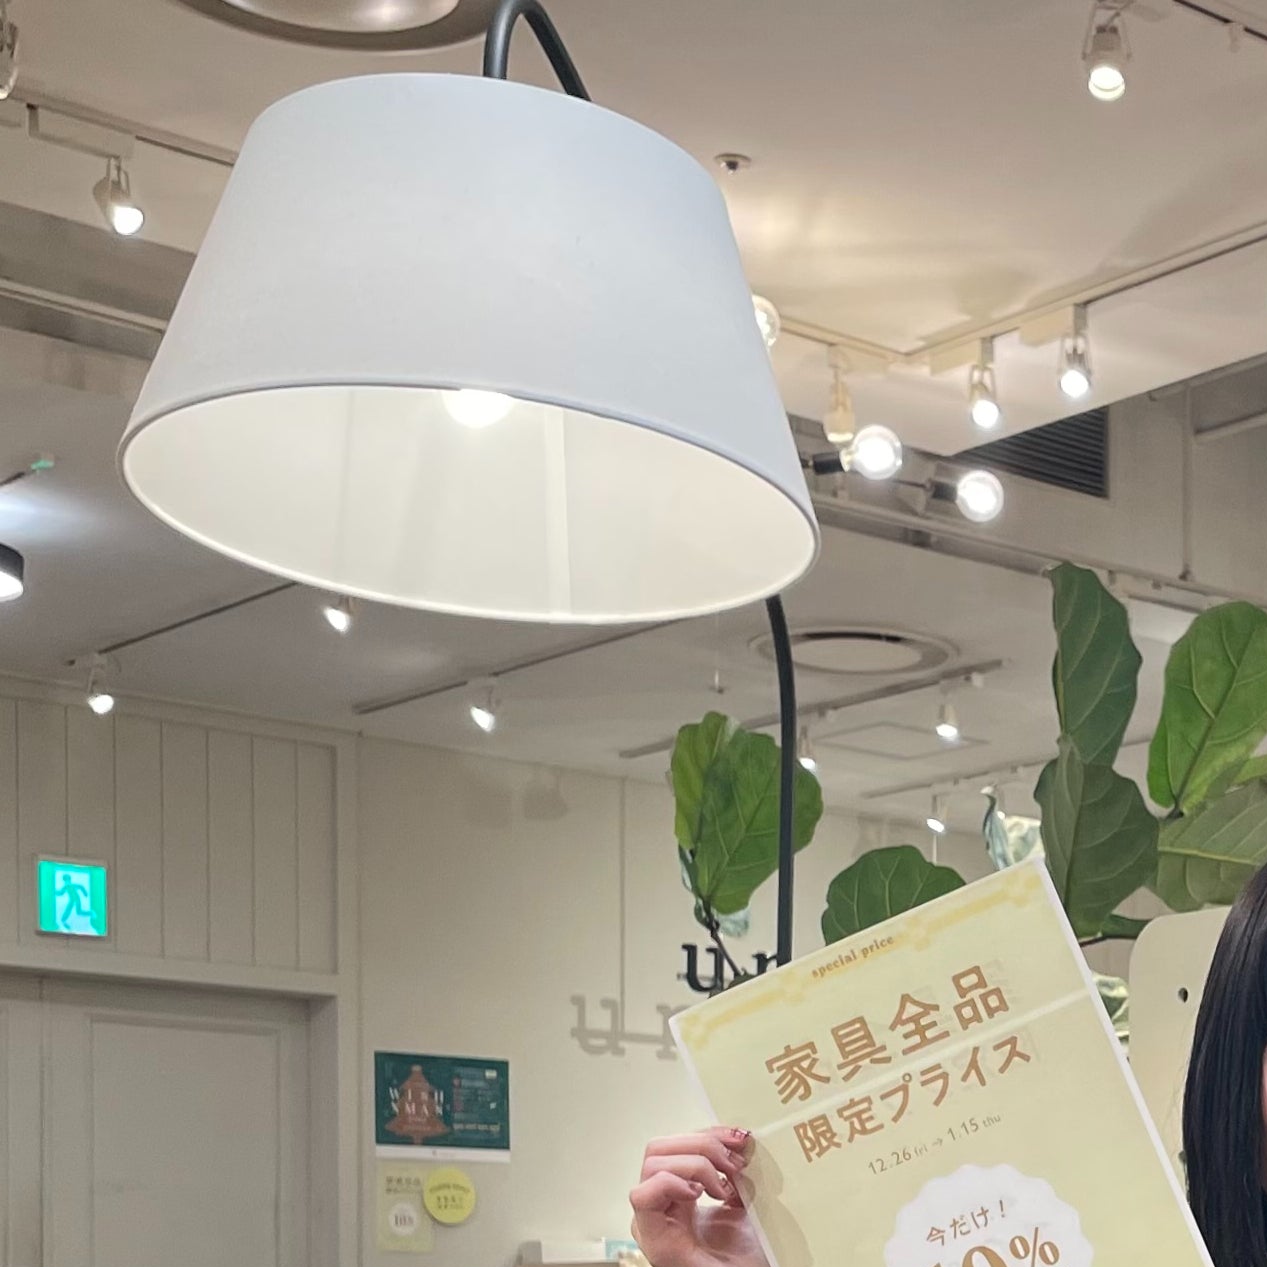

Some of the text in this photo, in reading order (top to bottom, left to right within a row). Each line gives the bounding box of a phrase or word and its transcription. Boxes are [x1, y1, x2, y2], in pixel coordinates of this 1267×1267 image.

[811, 936, 895, 978] special price
[764, 965, 1010, 1105] 家具全品
[793, 1035, 1031, 1163] 限定プライス
[868, 1149, 913, 1175] 12.26
[947, 1117, 980, 1142] 1.15
[982, 1114, 1001, 1129] thu
[926, 1199, 1007, 1247] 今だけ！
